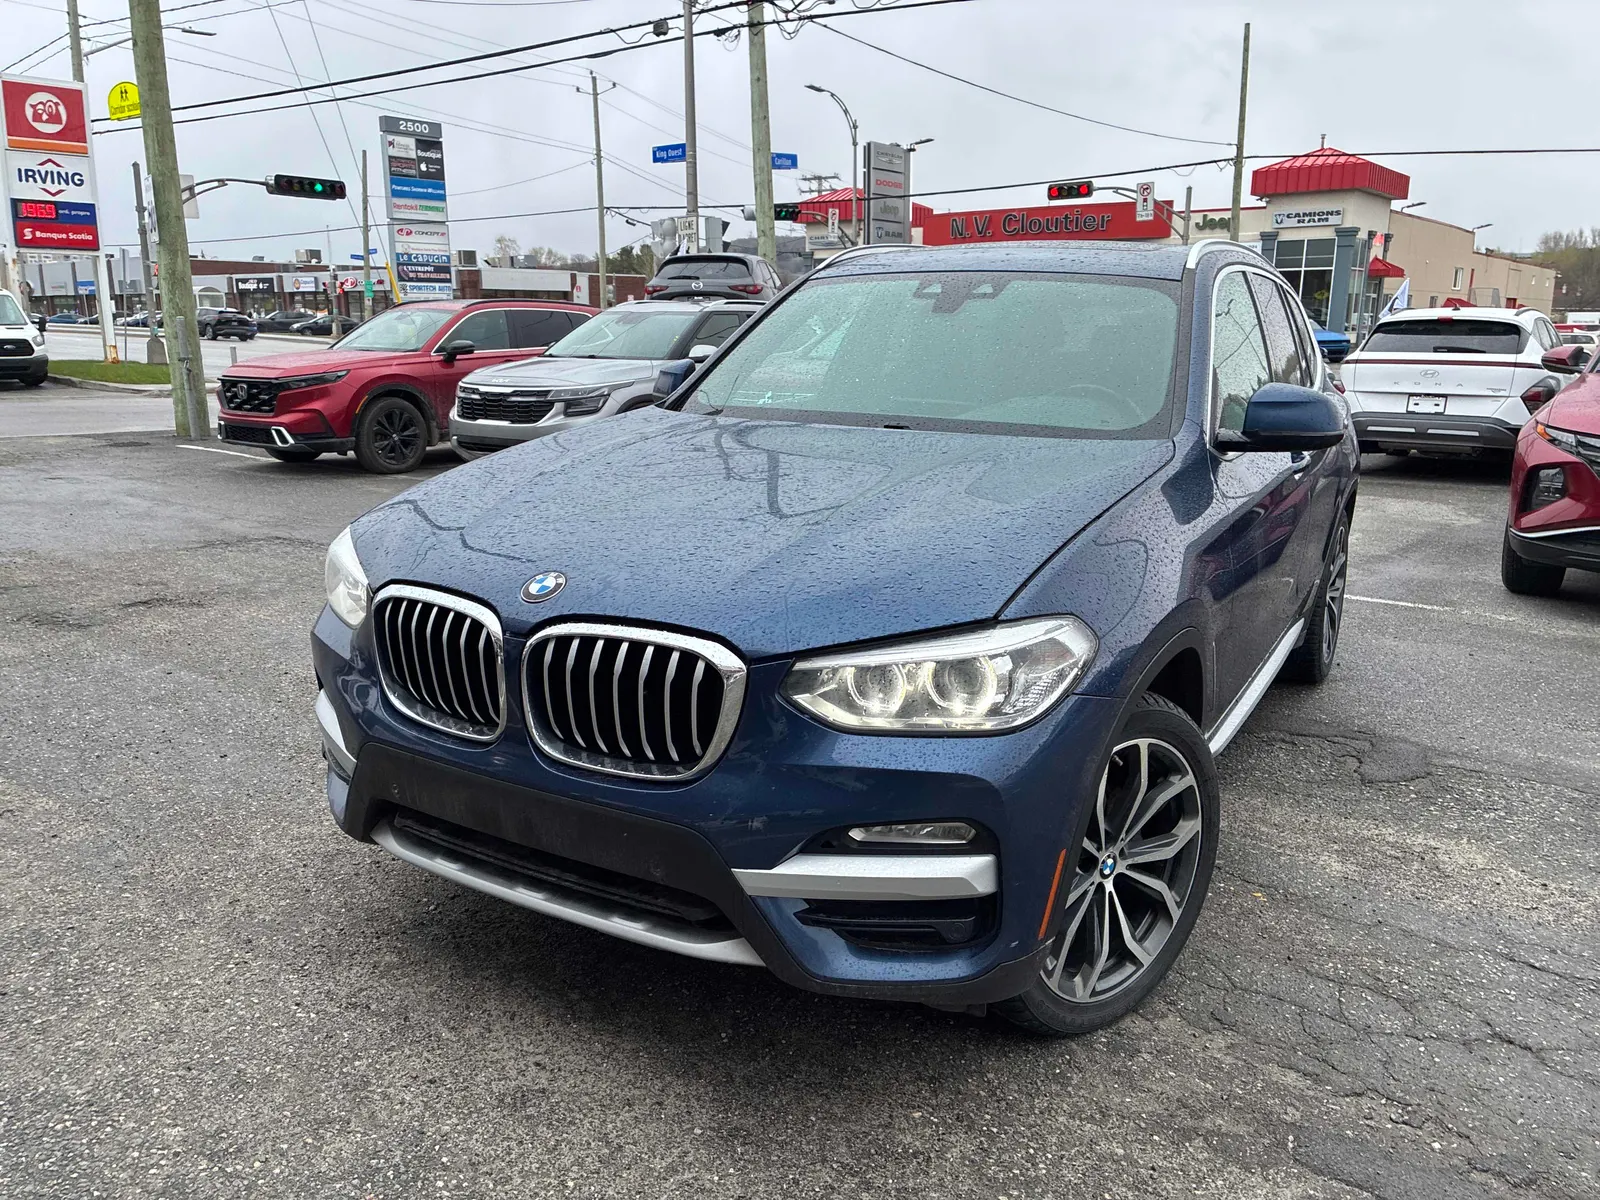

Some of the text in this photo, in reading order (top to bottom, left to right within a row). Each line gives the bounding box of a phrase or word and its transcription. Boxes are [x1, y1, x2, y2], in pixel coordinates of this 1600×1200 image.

[399, 121, 429, 133] 2500
[656, 148, 682, 160] King Ouest
[876, 150, 903, 160] CHRYSLER
[17, 167, 85, 187] IRVING
[875, 178, 903, 189] DODGE
[880, 201, 900, 217] Jeep
[1286, 210, 1341, 219] CAMIONS
[680, 219, 695, 231] LIGNE
[1002, 209, 1111, 235] Cloutier
[35, 230, 93, 241] Banque Scotia
[885, 231, 903, 239] RAM
